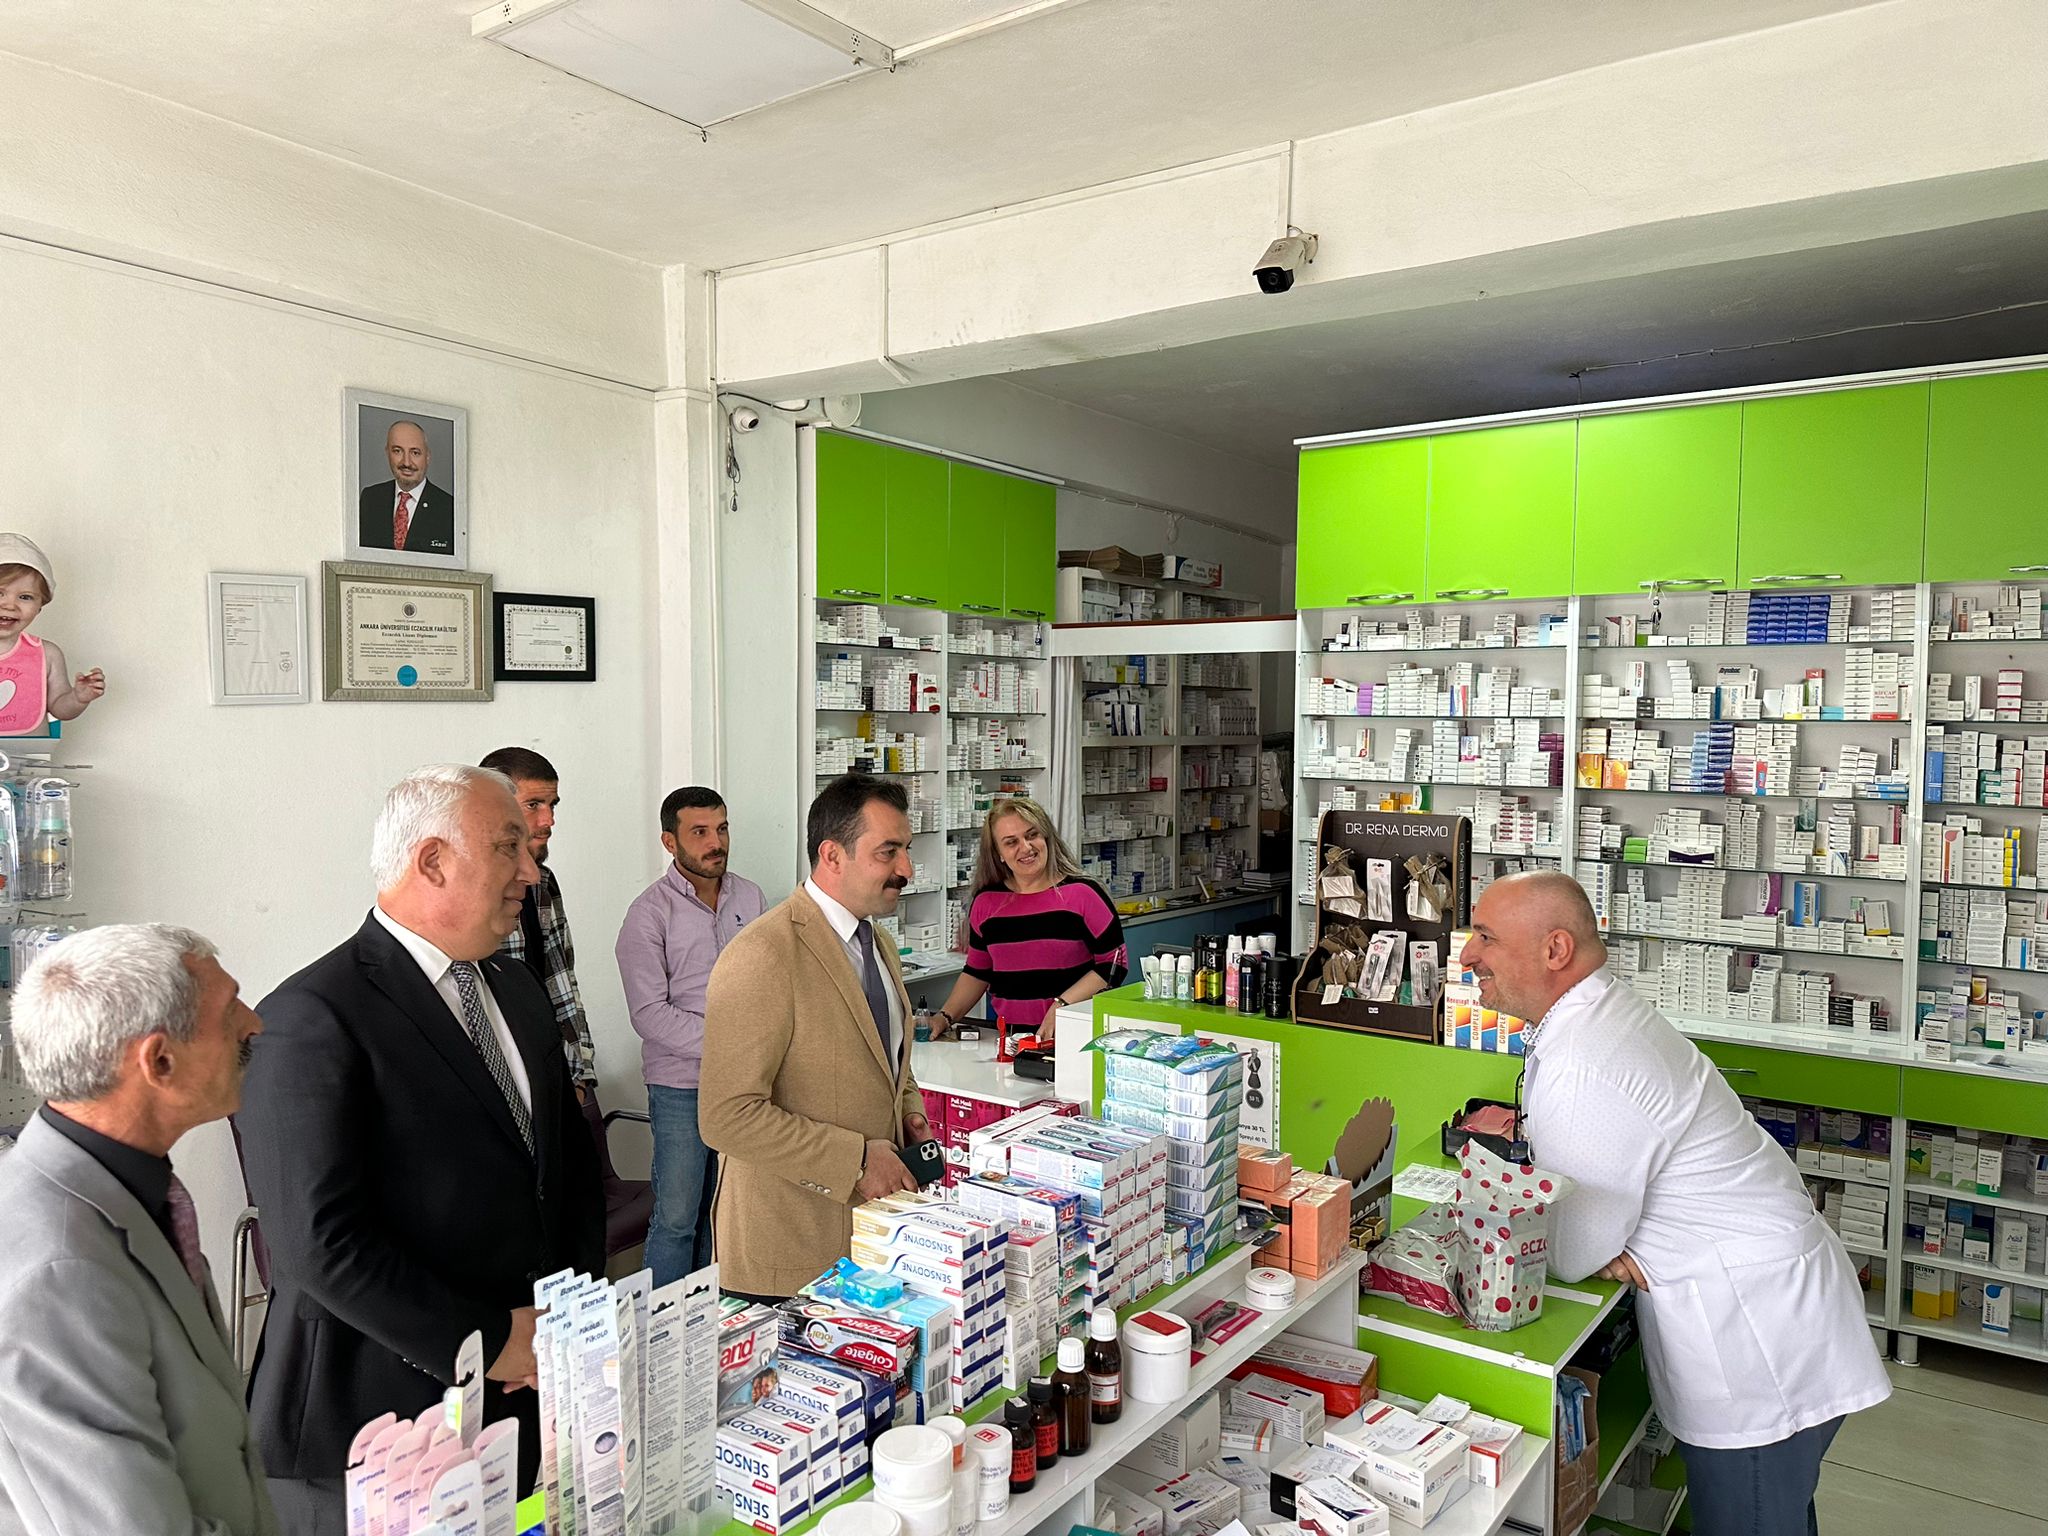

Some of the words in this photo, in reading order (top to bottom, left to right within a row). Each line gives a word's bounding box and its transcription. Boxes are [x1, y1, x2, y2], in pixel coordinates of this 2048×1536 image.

[1345, 822, 1363, 835] DR.
[1366, 824, 1400, 836] RENA
[1403, 825, 1449, 838] DERMO
[903, 1232, 953, 1254] SENSODYNE
[901, 1261, 952, 1285] SENSODYNE
[542, 1275, 566, 1292] Banat
[560, 1281, 584, 1297] Banat
[581, 1294, 608, 1310] Banat
[809, 1330, 835, 1344] Total
[842, 1318, 900, 1338] Colgate
[719, 1330, 755, 1369] and
[845, 1346, 894, 1369] Colgate
